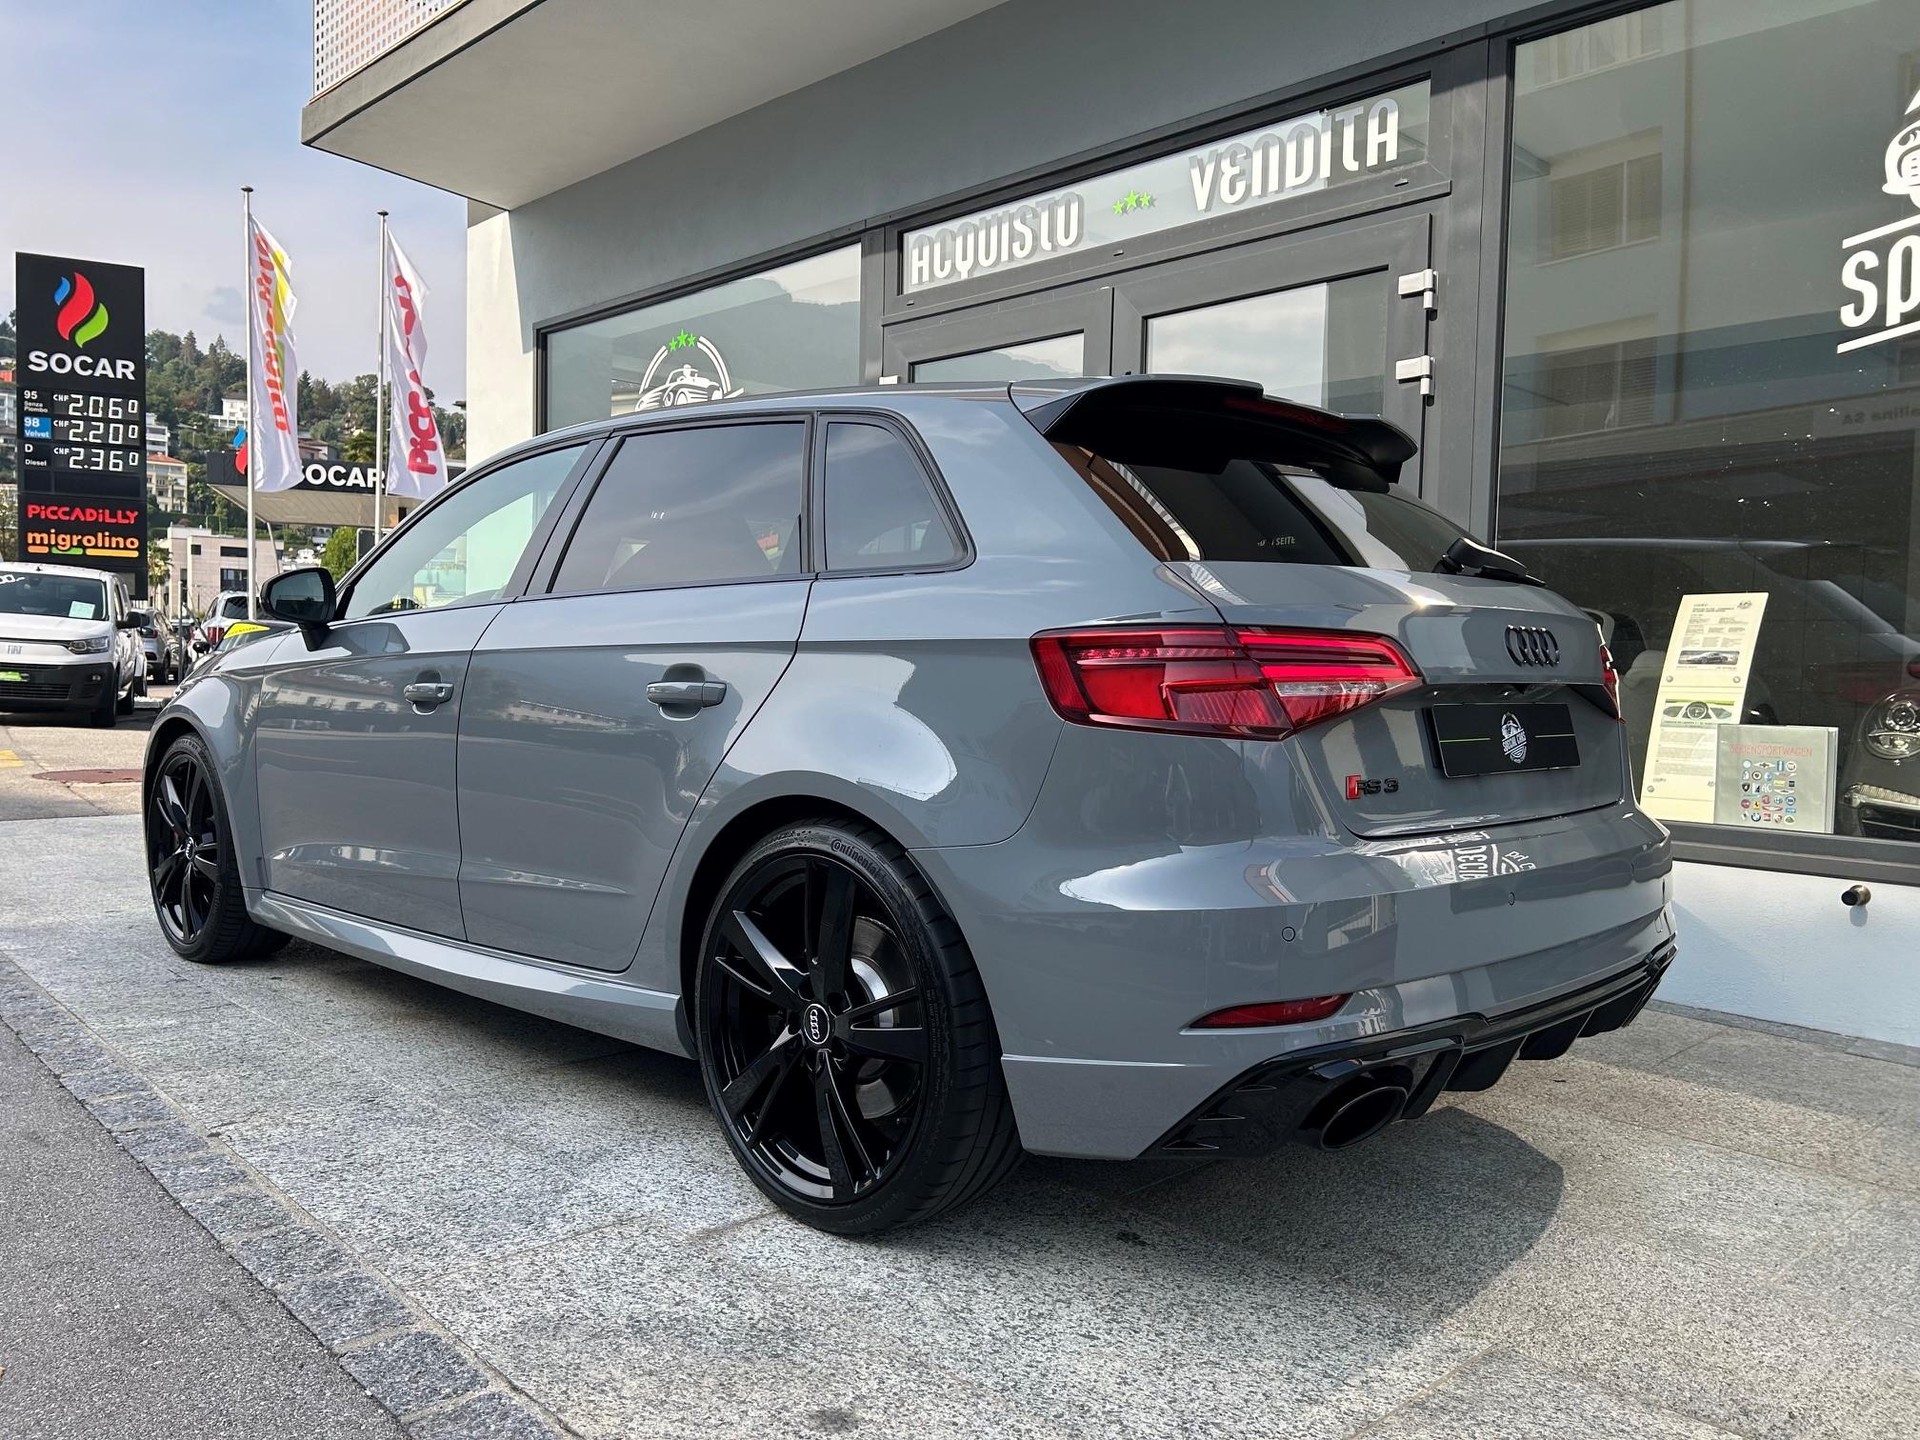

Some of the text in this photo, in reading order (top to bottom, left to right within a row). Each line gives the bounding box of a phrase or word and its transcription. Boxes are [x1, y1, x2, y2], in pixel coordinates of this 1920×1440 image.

[911, 193, 1081, 285] ACQUISTO
[27, 350, 136, 381] SOCAR
[23, 390, 38, 400] 95
[52, 394, 69, 402] CHF
[23, 417, 40, 428] 98
[53, 420, 70, 428] CHF
[24, 429, 50, 438] Velvet
[24, 443, 34, 453] D
[53, 447, 70, 455] CHF
[25, 459, 47, 467] Diesel
[301, 463, 386, 489] OCAR
[27, 528, 140, 551] migrolino
[7, 644, 22, 655] FIAT
[1383, 778, 1399, 794] 3
